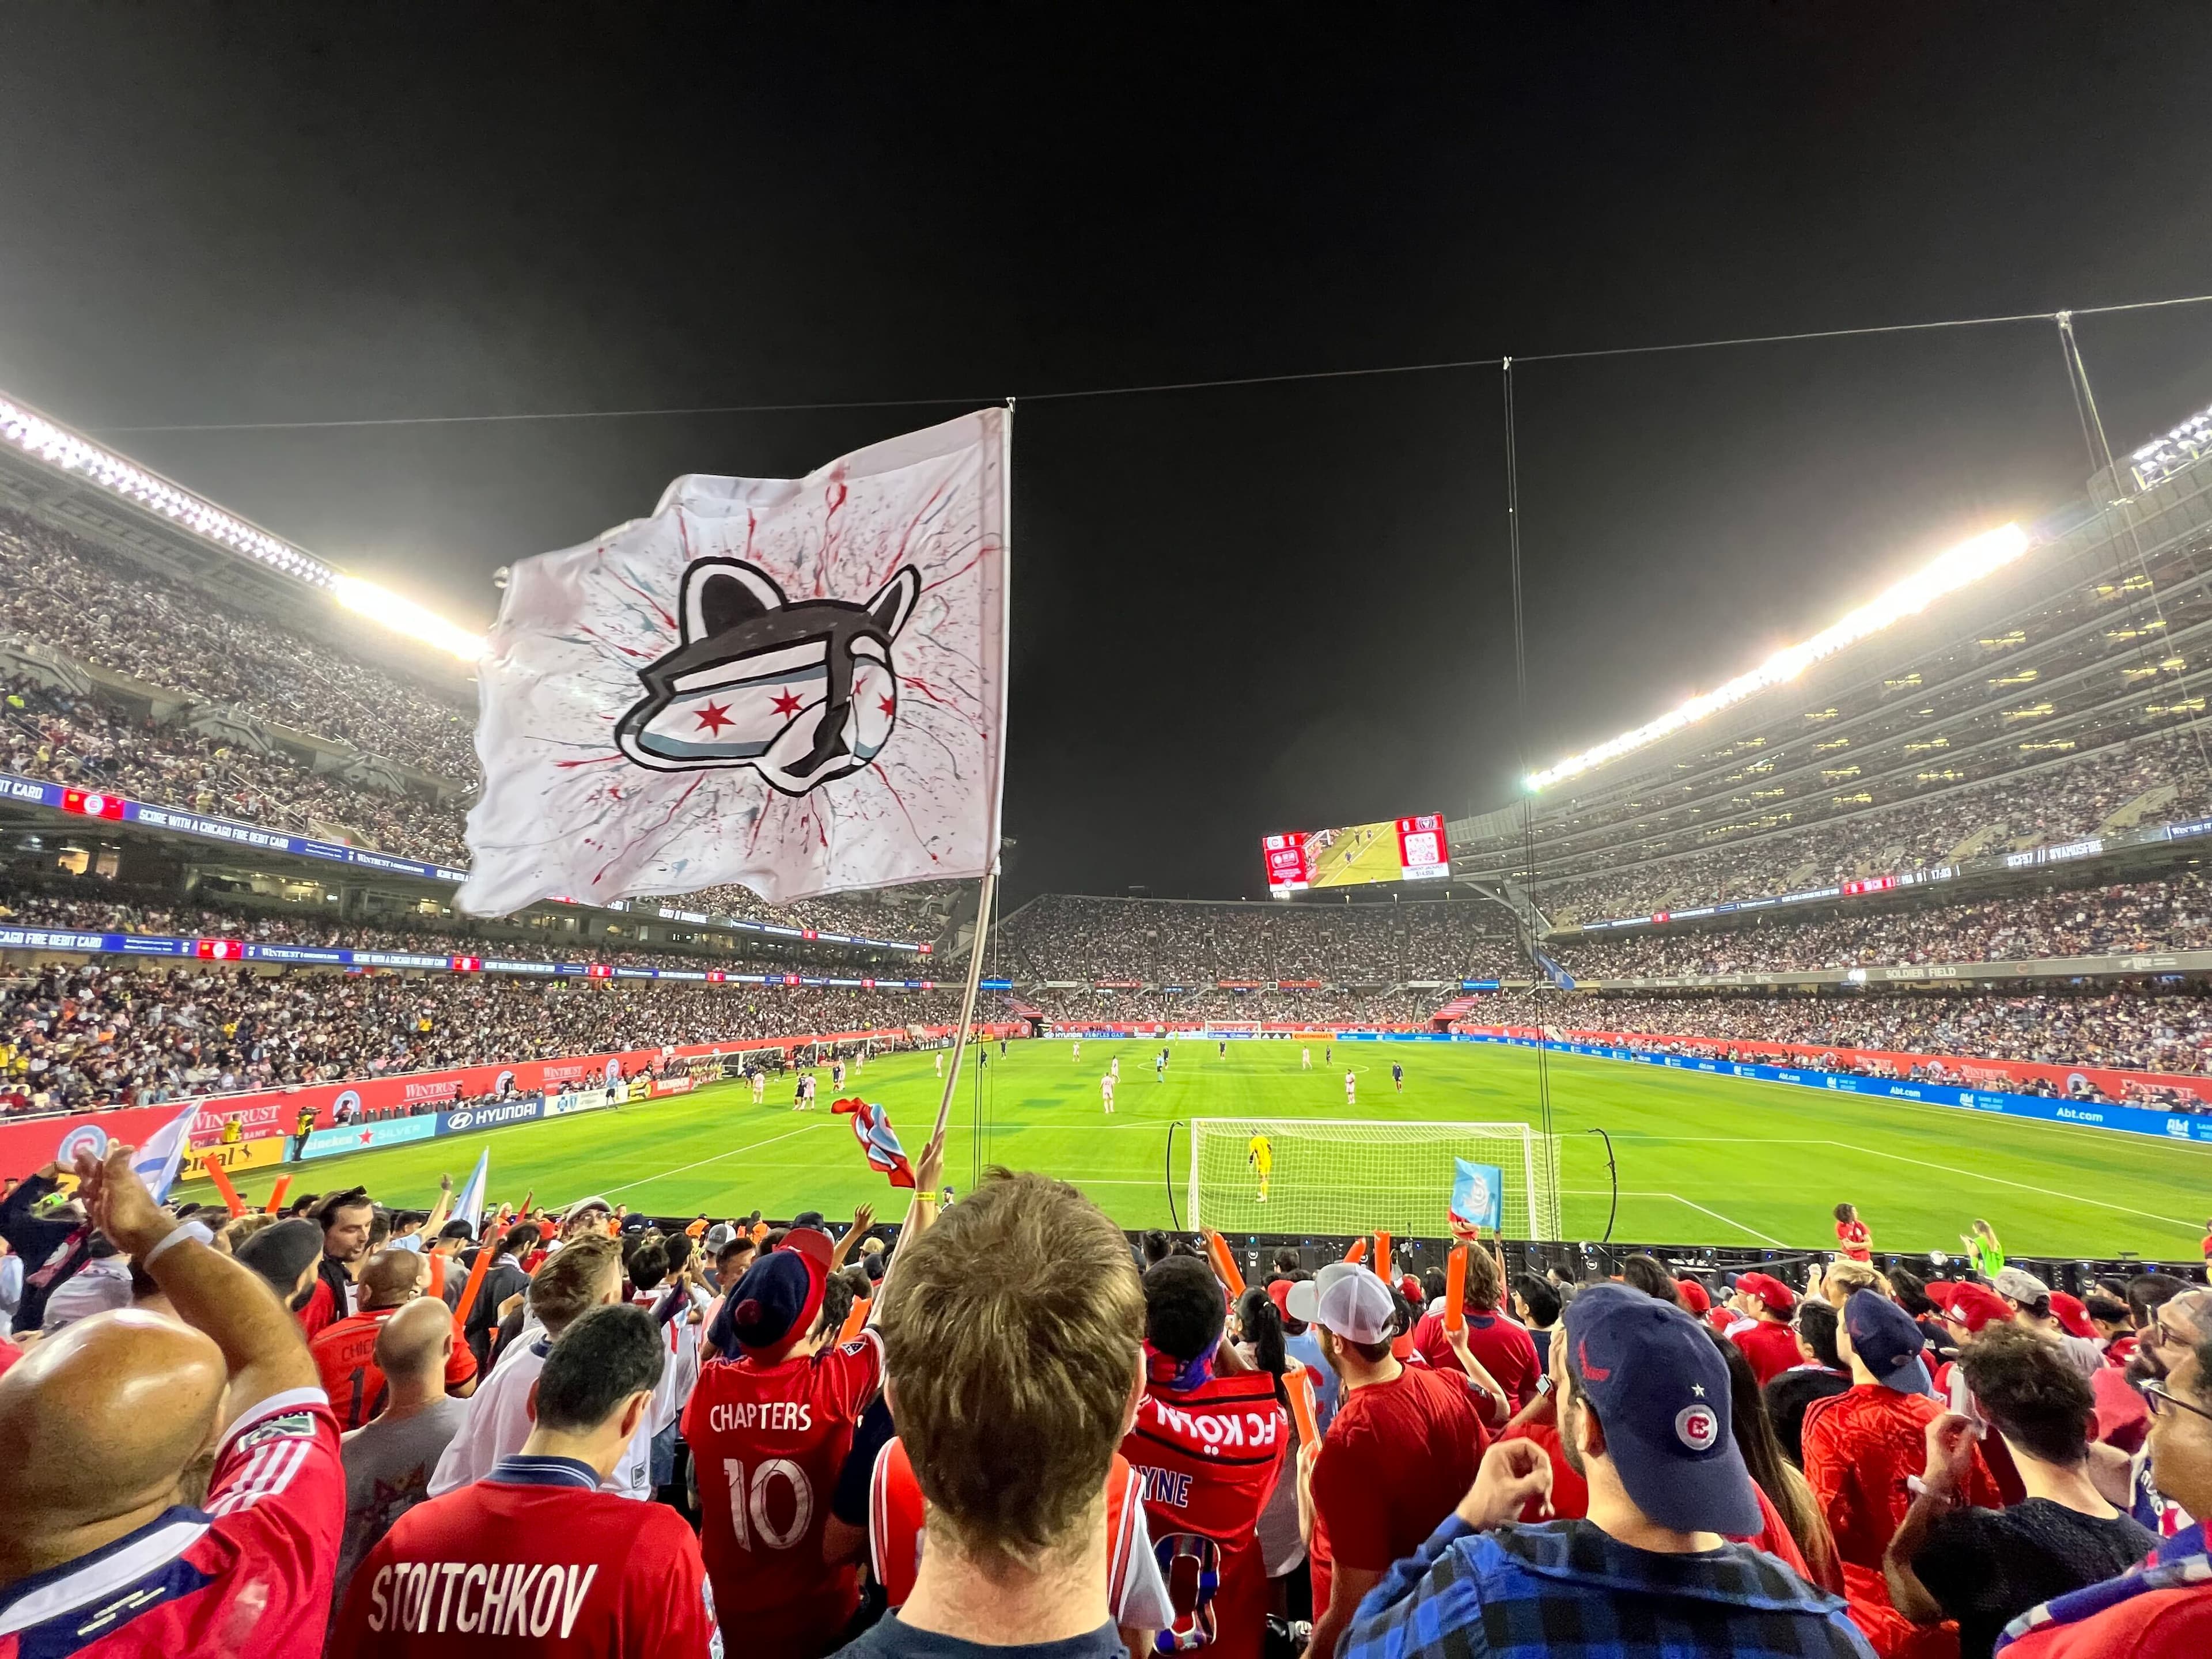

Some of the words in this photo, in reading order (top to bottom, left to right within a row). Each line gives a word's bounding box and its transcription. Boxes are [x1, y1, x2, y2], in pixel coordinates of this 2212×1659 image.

[12, 783, 44, 799] CARD
[138, 809, 167, 824] SCORE
[168, 815, 191, 831] WITH
[191, 821, 198, 831] A
[199, 821, 231, 837] CHICAGO
[232, 829, 249, 840] FIRE
[249, 832, 270, 844] DEBIT
[270, 836, 289, 849] CARD
[357, 853, 391, 867] WINTRUST
[25, 933, 48, 945] FIRE
[49, 934, 77, 946] DEBIT
[77, 936, 102, 948] CARD
[262, 948, 300, 958] WINTRUST
[1885, 968, 1924, 979] SOLDIER
[1929, 967, 1956, 977] FIELD
[543, 1066, 582, 1079] WINTRUST
[1890, 1086, 1921, 1098] Abt.com
[476, 1103, 536, 1124] HYUNDAI
[2056, 1107, 2103, 1122] Abt.com
[377, 1124, 421, 1139] SILVER
[2166, 1118, 2189, 1132] Abt
[342, 1338, 376, 1362] CHIC
[710, 1403, 812, 1432] CHAPTERS
[1247, 1412, 1276, 1446] FC
[1130, 1464, 1193, 1508] YNE
[723, 1458, 813, 1552] 10
[368, 1562, 599, 1639] STOITCHKOV
